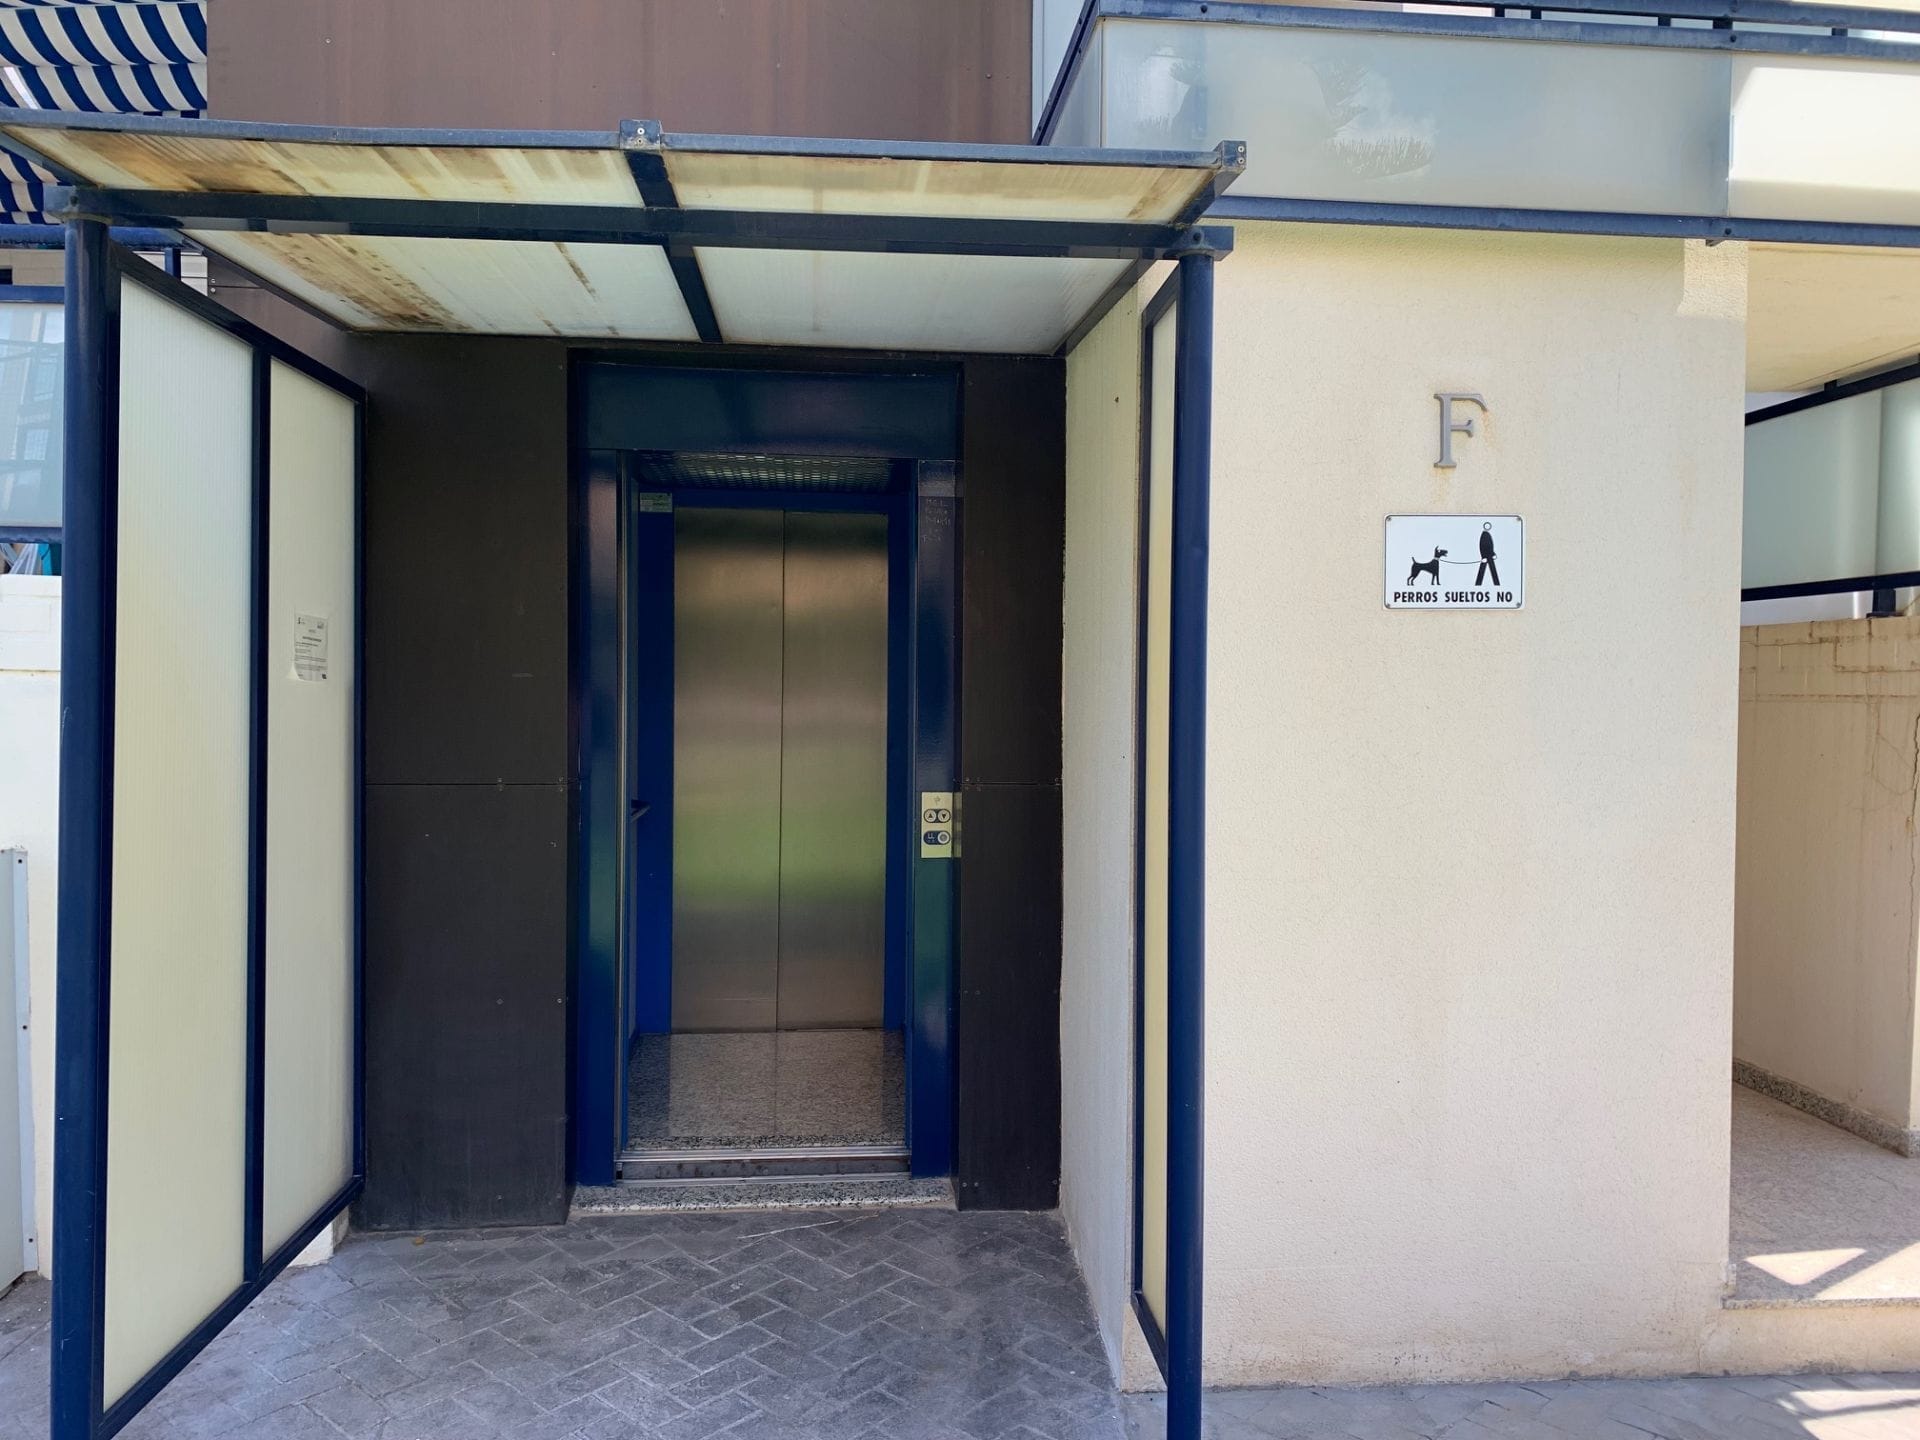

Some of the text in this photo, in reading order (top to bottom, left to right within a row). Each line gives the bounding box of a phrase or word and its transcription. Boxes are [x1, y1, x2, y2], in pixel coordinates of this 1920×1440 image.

[1434, 393, 1488, 468] F
[1394, 591, 1513, 603] PERROS SUELTOS NO
